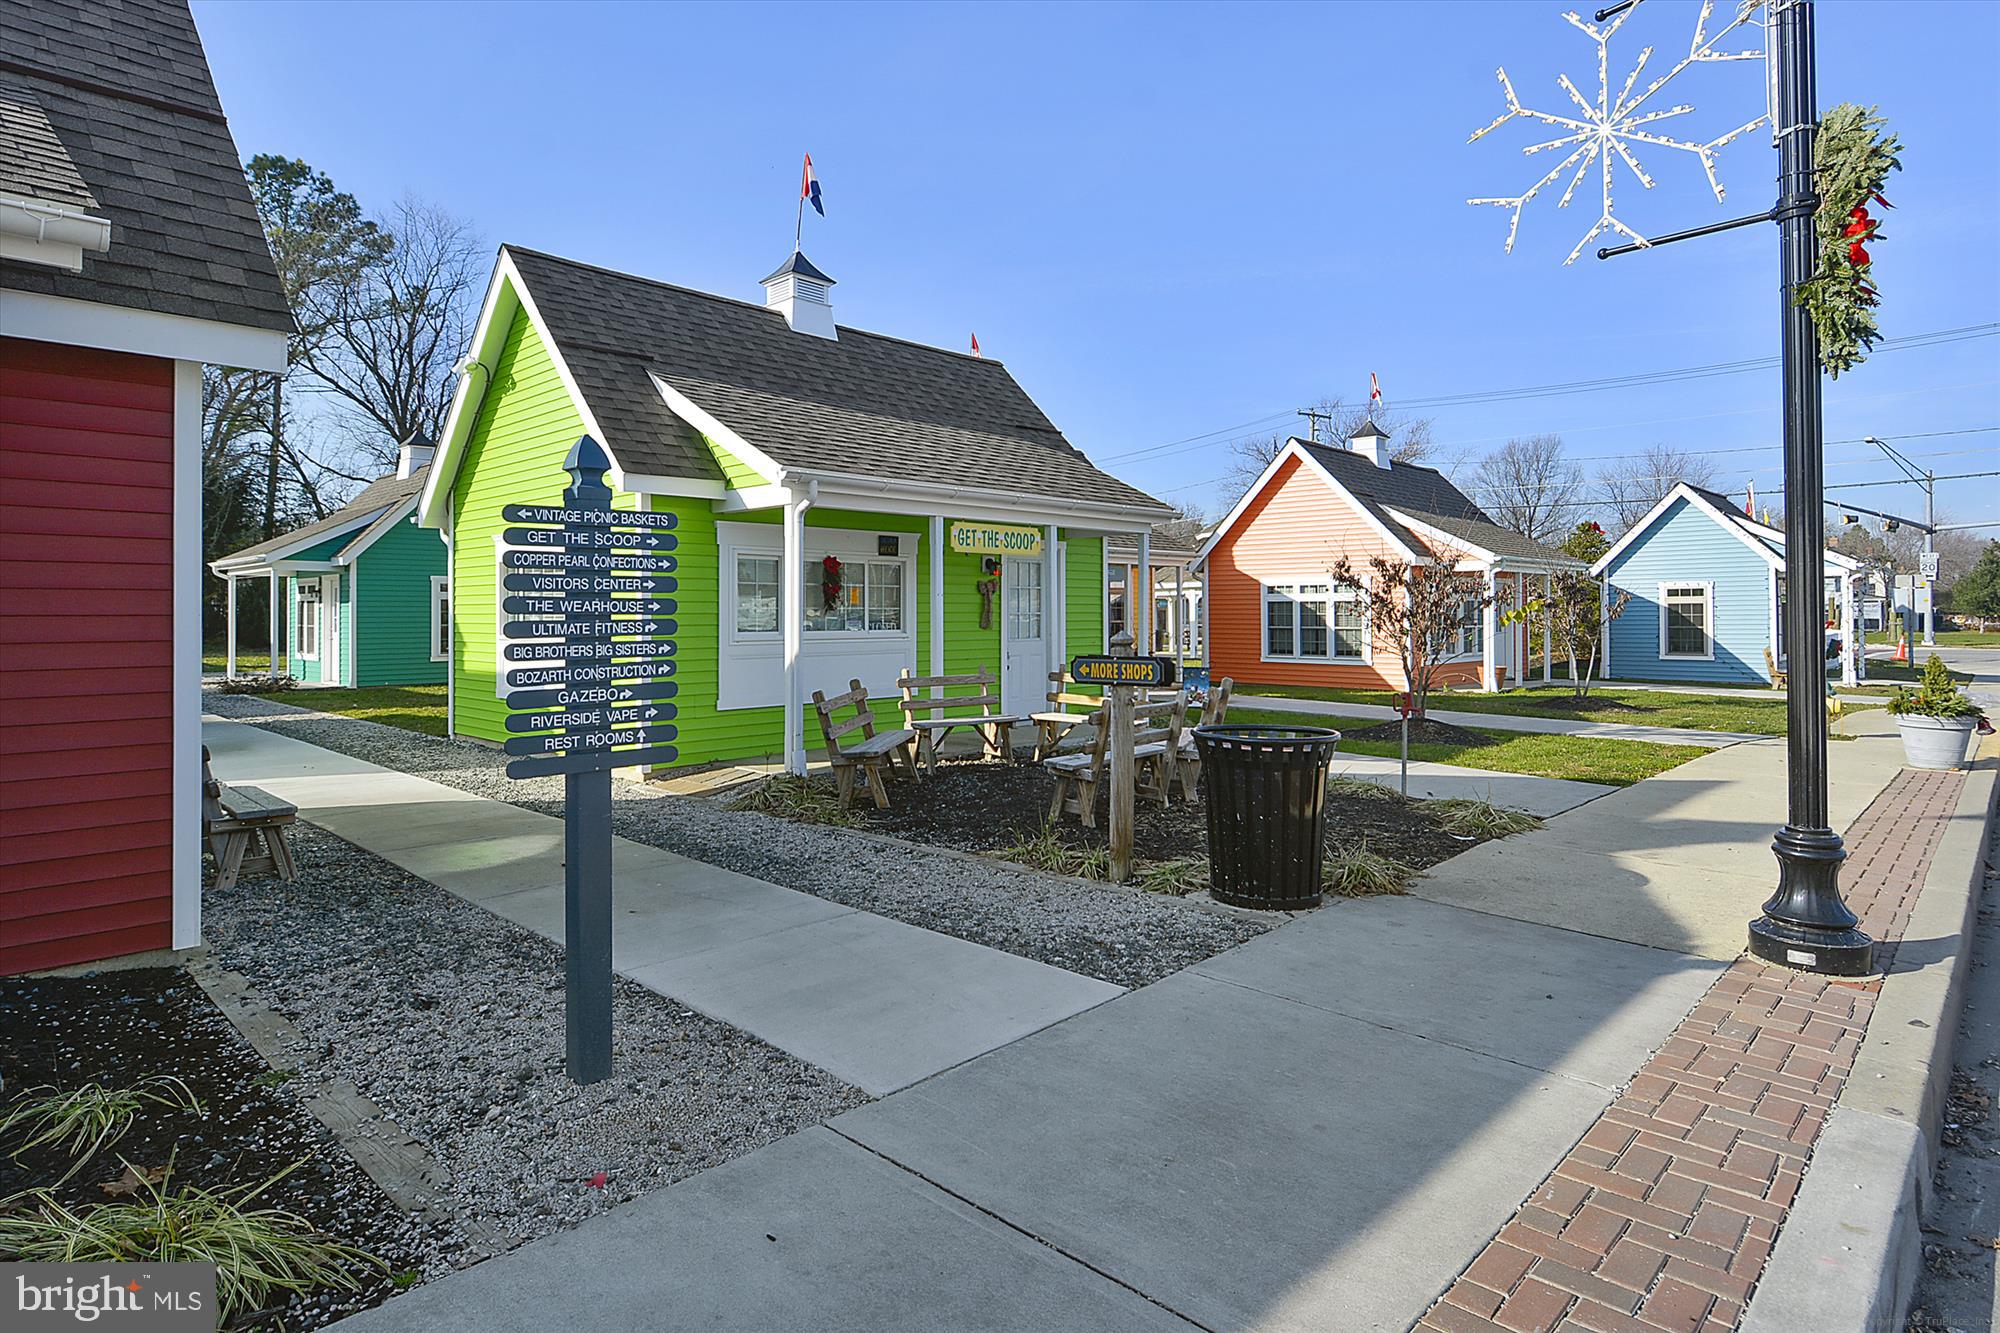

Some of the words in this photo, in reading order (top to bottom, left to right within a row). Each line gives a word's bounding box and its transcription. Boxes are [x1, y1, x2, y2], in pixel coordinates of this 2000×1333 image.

[534, 509, 581, 522] VINTAGE
[584, 511, 618, 524] PICNIC
[621, 513, 668, 526] BASKETS
[527, 531, 556, 543] GET
[563, 532, 589, 544] THE
[594, 534, 641, 546] SCOOP
[958, 528, 977, 546] GET
[982, 530, 999, 548] THE
[1004, 532, 1035, 550] SCOOP
[514, 553, 556, 566] COPPER
[558, 555, 590, 567] PEARL
[592, 556, 657, 569] CONFECTIONS
[1921, 563, 1936, 571] 20
[533, 577, 589, 589] VISITORS
[594, 578, 641, 590] CENTER
[526, 600, 553, 612] THE
[560, 600, 644, 612] WEARHOUSE
[532, 623, 590, 635] ULTIMATE
[595, 621, 642, 634] FITNESS
[513, 647, 532, 659] BIG
[535, 645, 593, 658] BROTHERS
[596, 644, 612, 656] BIG
[615, 643, 656, 655] SISTERS
[517, 670, 571, 683] BOZARTH
[574, 665, 656, 680] CONSTRUCTION
[1090, 663, 1118, 678] MORE
[1121, 664, 1153, 680] SHOPS
[558, 688, 618, 703] GAZEBO
[531, 711, 600, 728] RIVERSIDE
[606, 708, 638, 721] VAPE
[545, 736, 580, 750] REST
[586, 731, 633, 747] ROOMS
